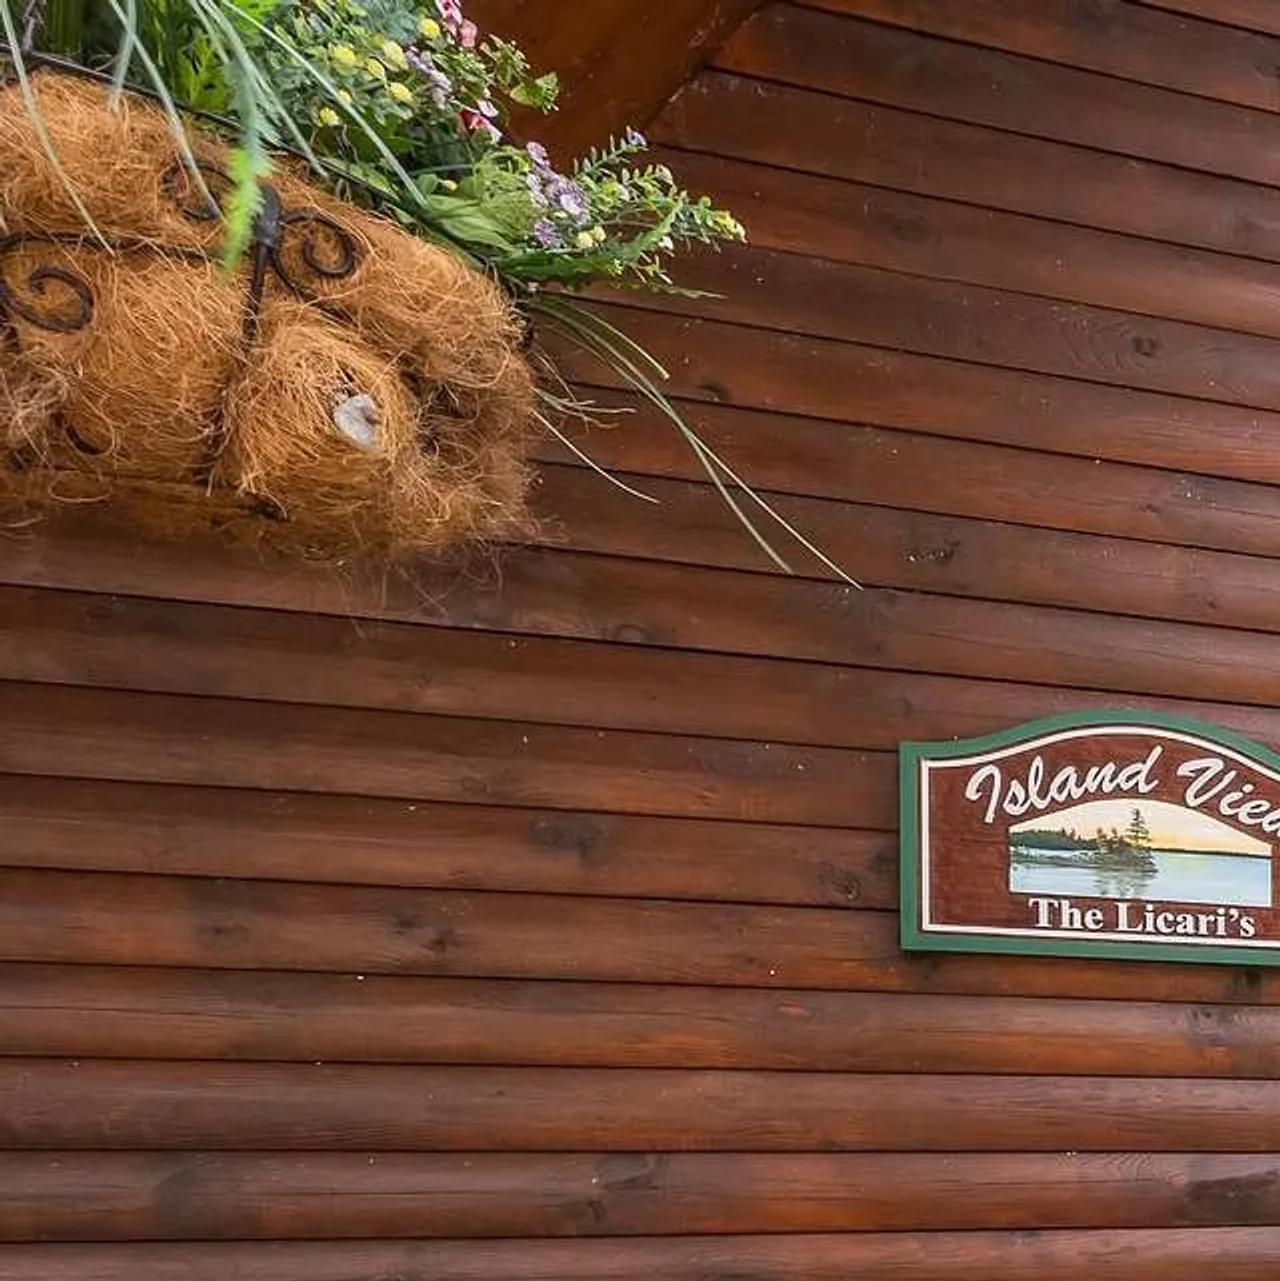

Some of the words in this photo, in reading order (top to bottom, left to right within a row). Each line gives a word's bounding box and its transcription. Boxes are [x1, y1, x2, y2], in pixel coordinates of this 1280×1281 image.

[965, 745, 1163, 824] Island
[1028, 897, 1105, 931] The
[1116, 902, 1256, 938] Licari's
